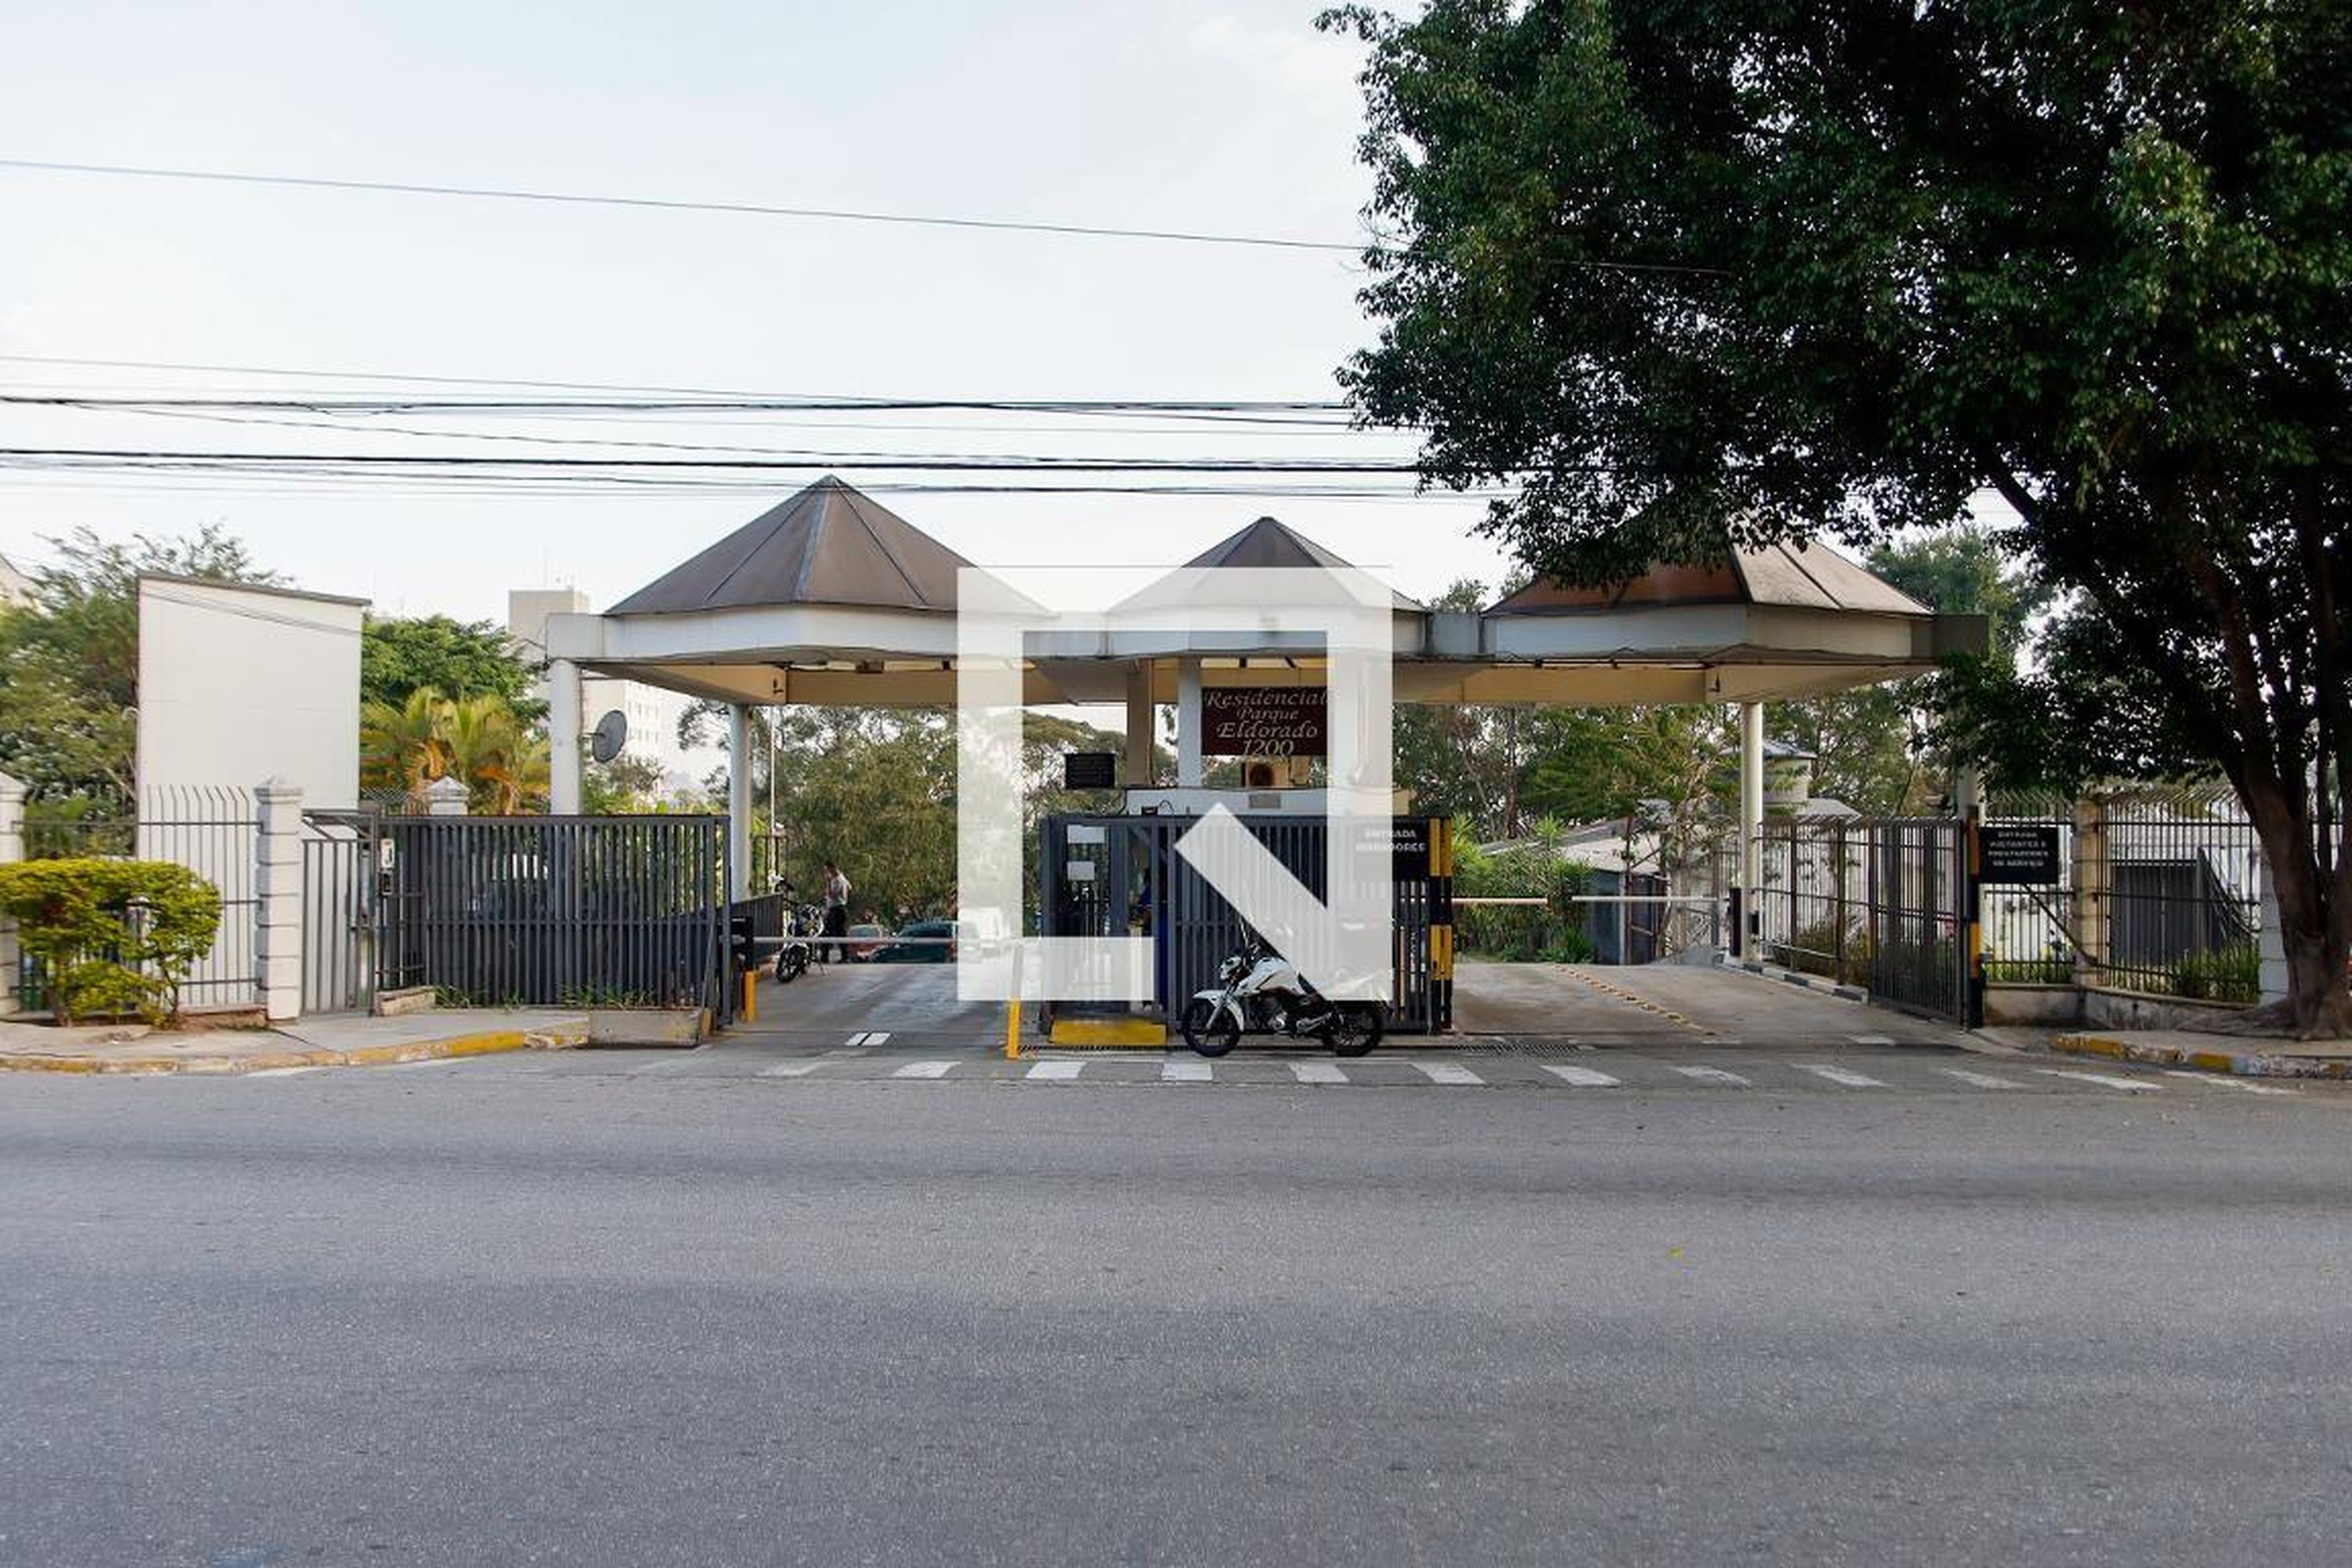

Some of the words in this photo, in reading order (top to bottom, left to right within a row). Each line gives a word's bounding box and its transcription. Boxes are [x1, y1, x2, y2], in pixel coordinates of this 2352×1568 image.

[1206, 687, 1330, 709] Residencial
[1236, 708, 1299, 724] Parque
[1216, 720, 1318, 738] Eldorado
[1242, 739, 1294, 758] 1200
